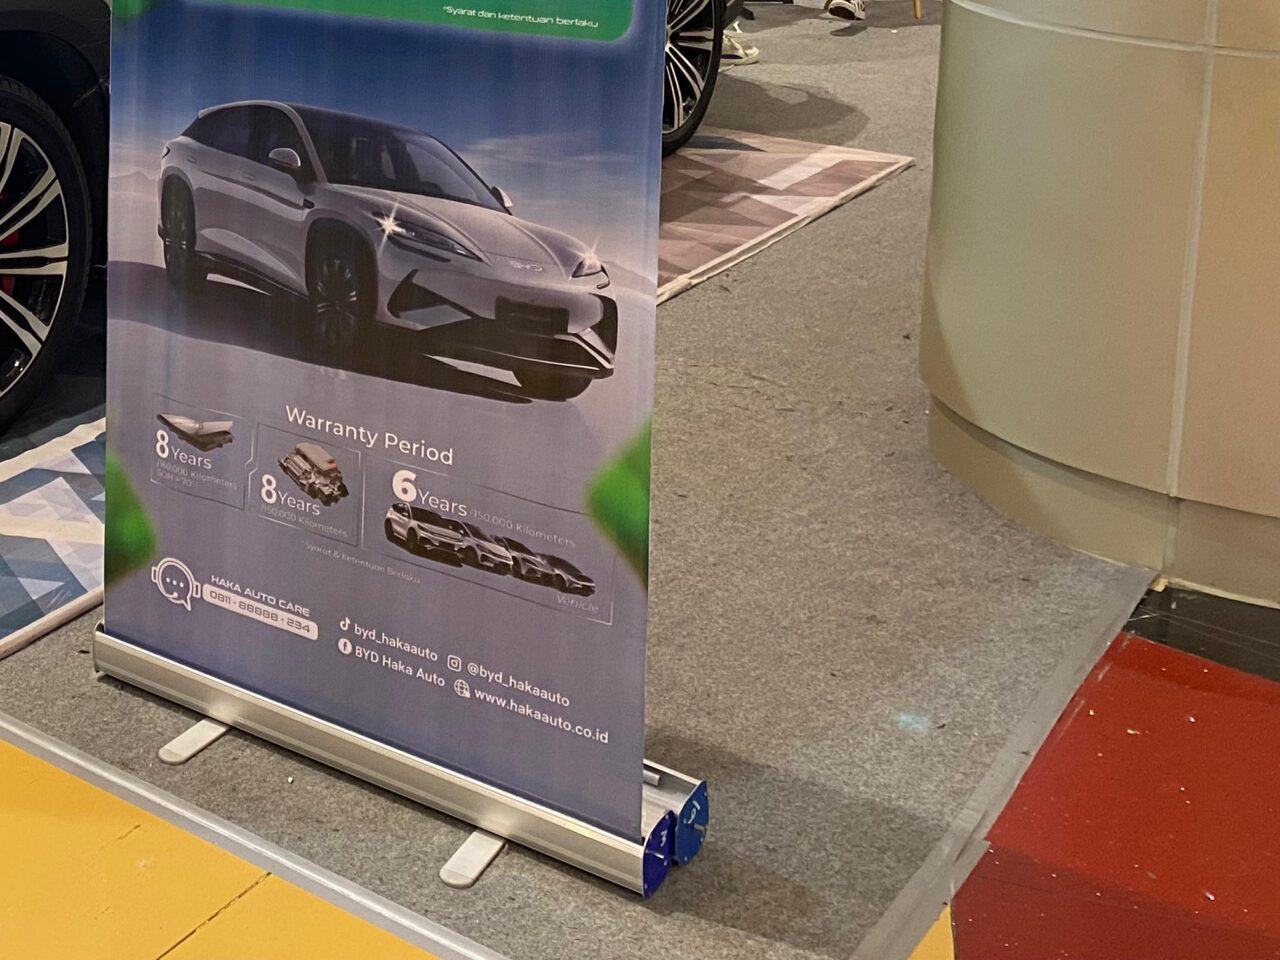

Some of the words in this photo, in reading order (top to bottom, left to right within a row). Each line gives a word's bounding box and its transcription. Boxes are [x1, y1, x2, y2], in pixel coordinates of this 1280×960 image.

[478, 10, 496, 19] dan
[498, 12, 554, 24] ketentuan
[556, 17, 599, 28] berlaku
[155, 429, 169, 458] 8
[171, 447, 212, 469] Years
[285, 405, 378, 448] Warranty
[385, 432, 453, 466] Period
[260, 474, 277, 504] 8
[278, 490, 321, 516] Years
[392, 470, 417, 502] 6
[418, 488, 468, 517] Years
[516, 523, 576, 548] Kilometers
[211, 575, 241, 592] HAKA
[244, 587, 276, 605] AUTO
[278, 599, 310, 617] CARE
[354, 623, 438, 661] byd_hakaauto
[467, 662, 570, 707] @byd_hakaauto
[355, 645, 379, 663] BYD
[382, 655, 412, 676] Haka
[416, 668, 446, 687] Auto
[474, 688, 609, 744] www.hakaauto.co.id
